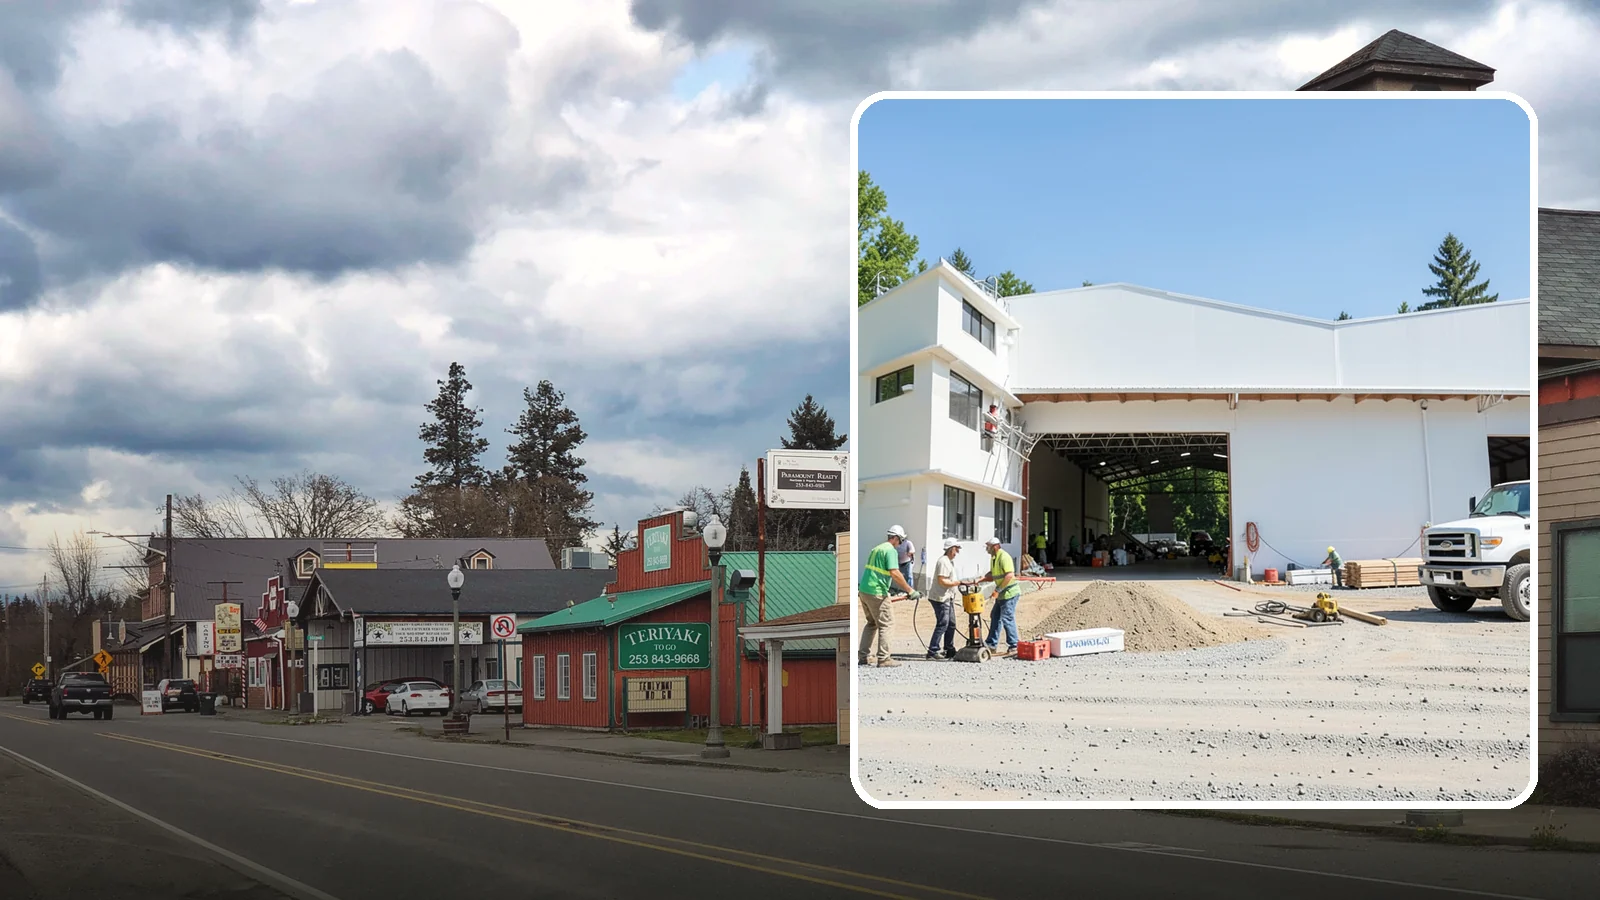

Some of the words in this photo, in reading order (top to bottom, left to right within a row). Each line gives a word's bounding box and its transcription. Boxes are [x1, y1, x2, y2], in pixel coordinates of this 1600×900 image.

[625, 627, 702, 646] TERIYAKI
[629, 654, 649, 665] 253
[651, 653, 700, 664] 843-9668
